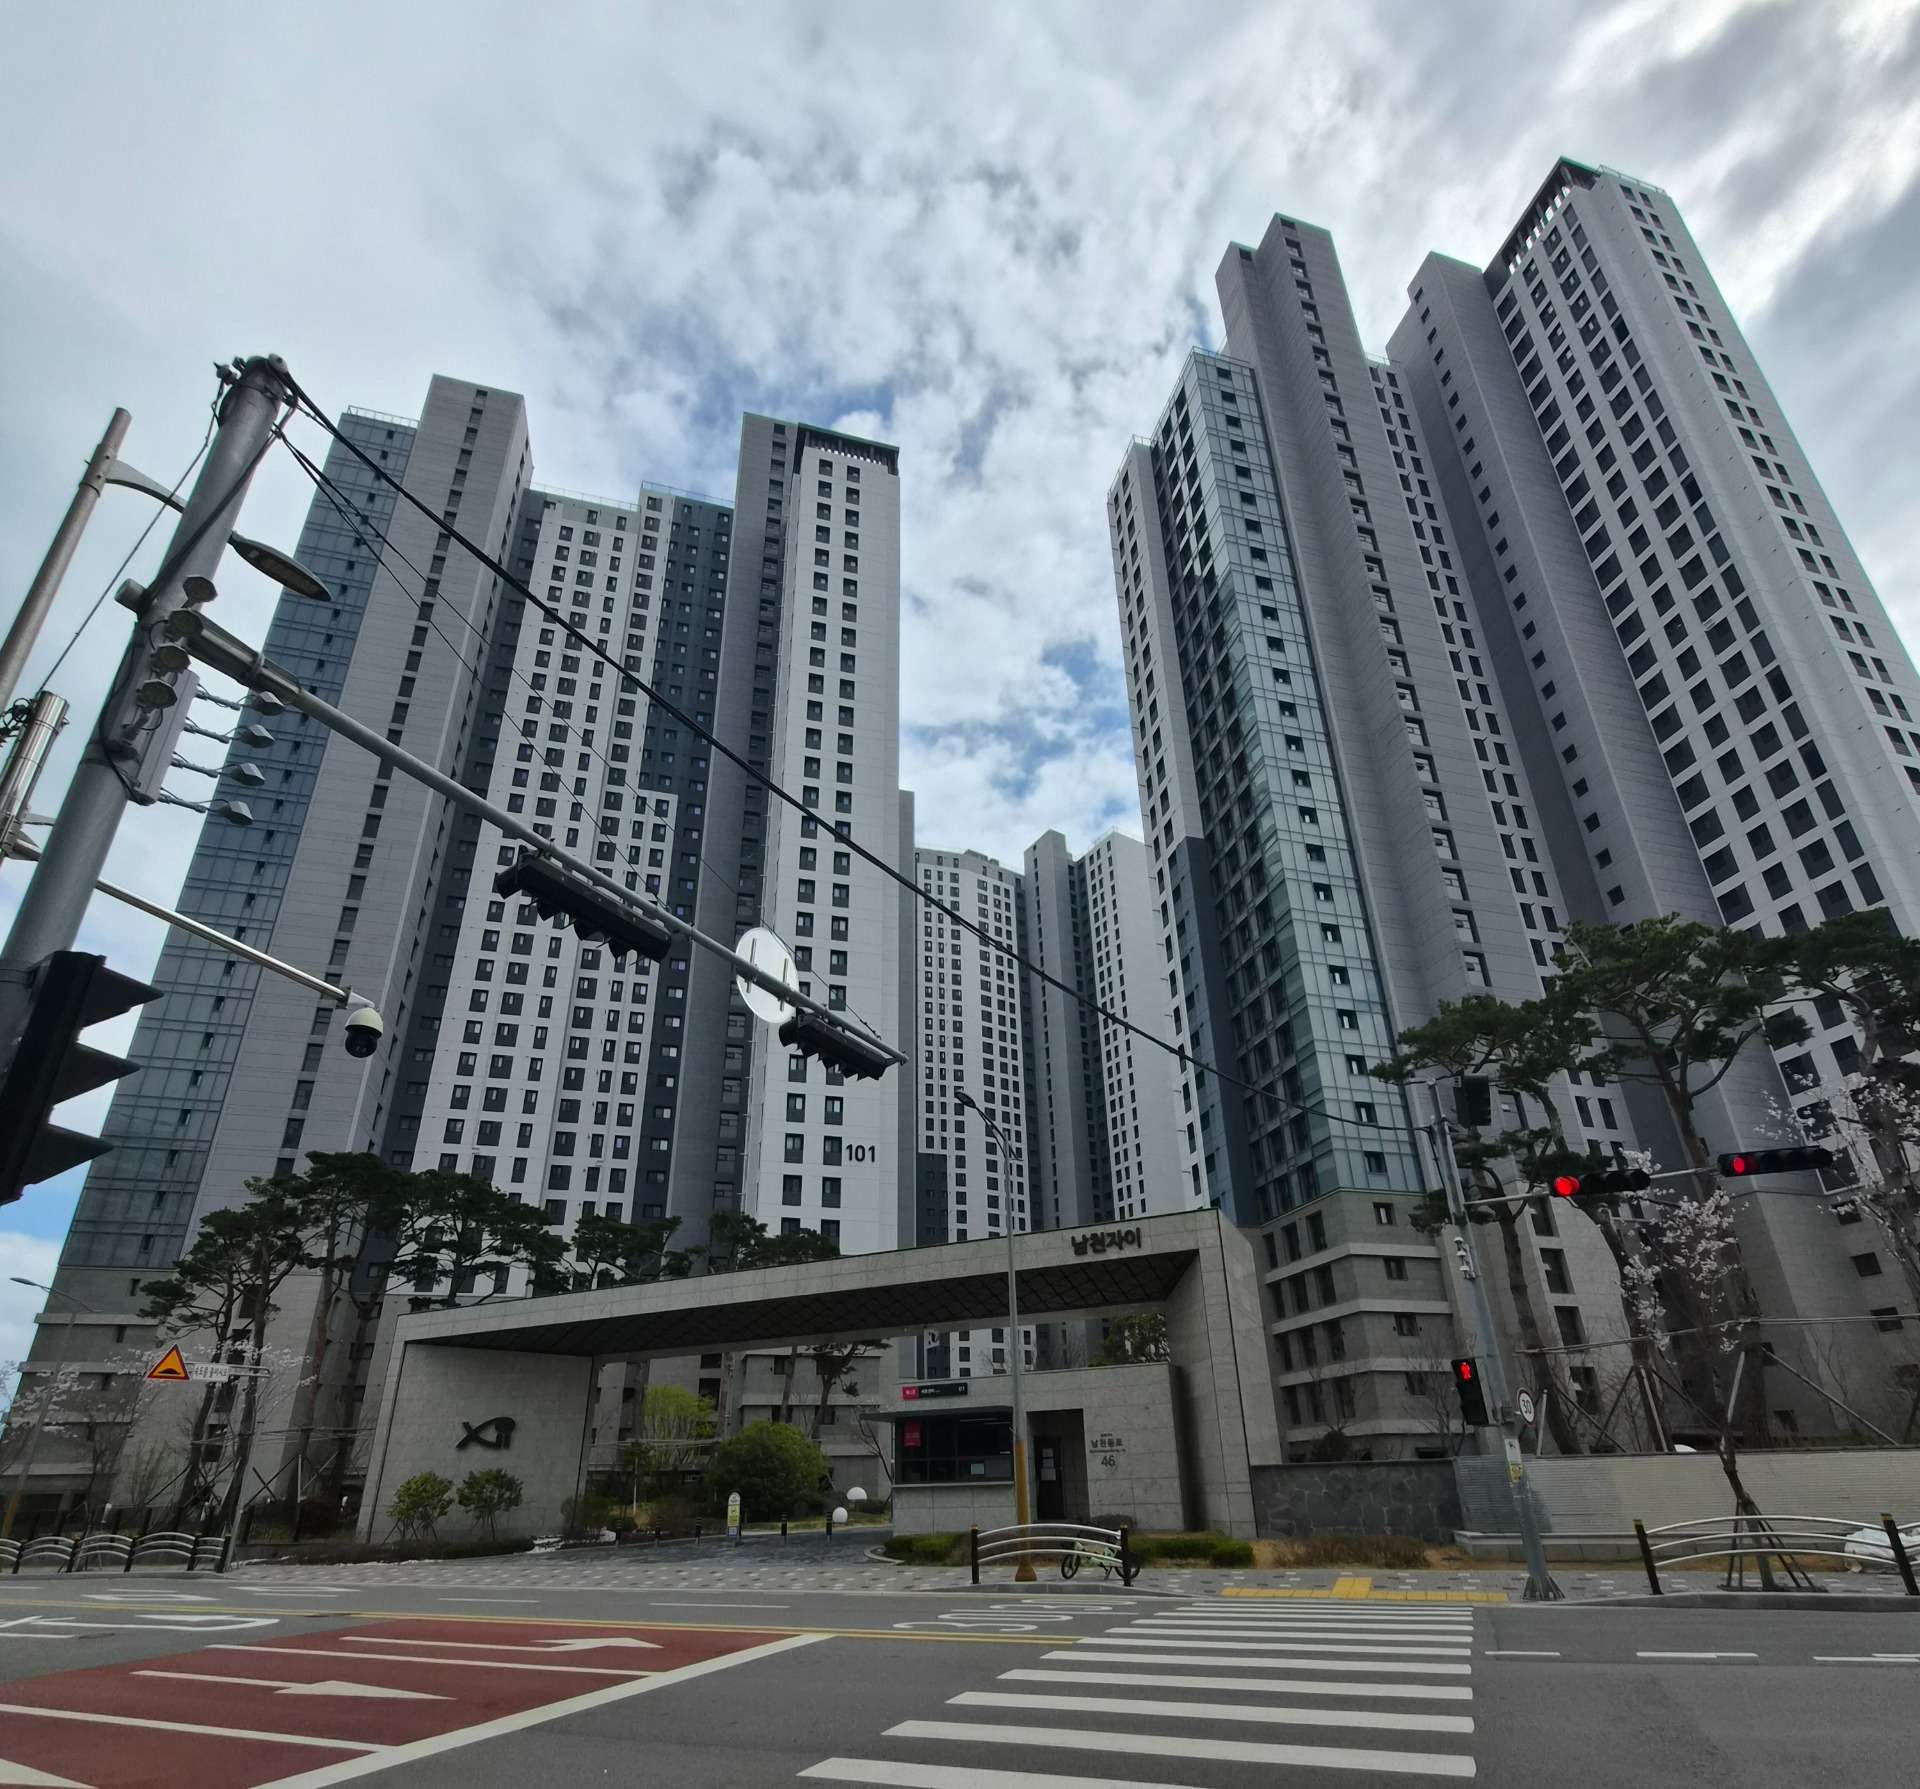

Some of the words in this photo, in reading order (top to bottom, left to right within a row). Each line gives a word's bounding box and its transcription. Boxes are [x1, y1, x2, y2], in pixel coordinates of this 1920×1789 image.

[845, 1143, 876, 1163] 101
[1071, 1227, 1142, 1255] 남천자이
[194, 1366, 209, 1378] 속도를
[1521, 1399, 1532, 1414] 30
[1101, 1455, 1116, 1467] 46
